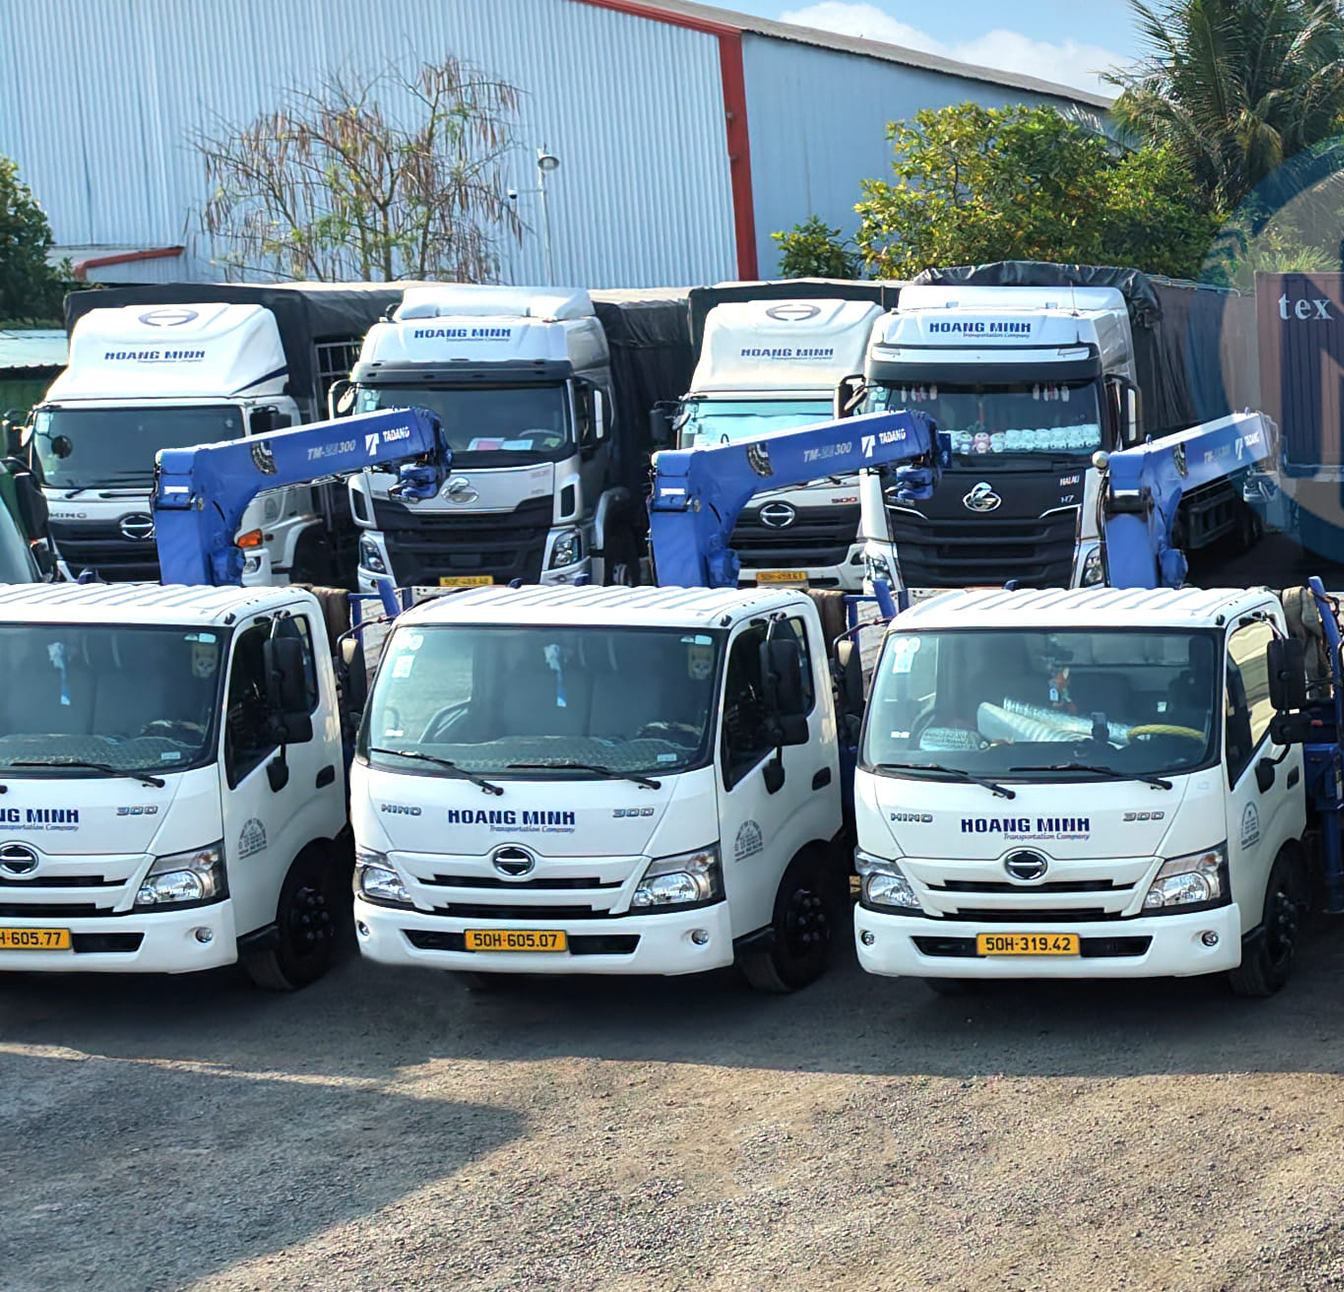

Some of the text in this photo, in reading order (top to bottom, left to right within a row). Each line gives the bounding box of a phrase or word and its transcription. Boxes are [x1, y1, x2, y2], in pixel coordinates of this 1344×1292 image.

[1278, 293, 1335, 320] tex
[930, 322, 1031, 333] HOANG MINH
[414, 328, 511, 339] HOANG MINH
[104, 350, 206, 361] HOANG MINH
[741, 348, 834, 357] HOANG MINH
[116, 805, 159, 816] 300
[381, 803, 422, 816] HINO
[612, 807, 655, 818] 300
[26, 808, 79, 824] MINH
[448, 809, 576, 825] HOANG MINH
[890, 812, 933, 823] HINO
[1122, 811, 1165, 822] 300
[489, 824, 576, 834] Transportation Company
[961, 817, 1090, 833] HOANG MINH
[1003, 832, 1091, 842] Transportation Company
[473, 933, 557, 948] 50H-605.07
[985, 937, 1071, 951] 50H-319.42
